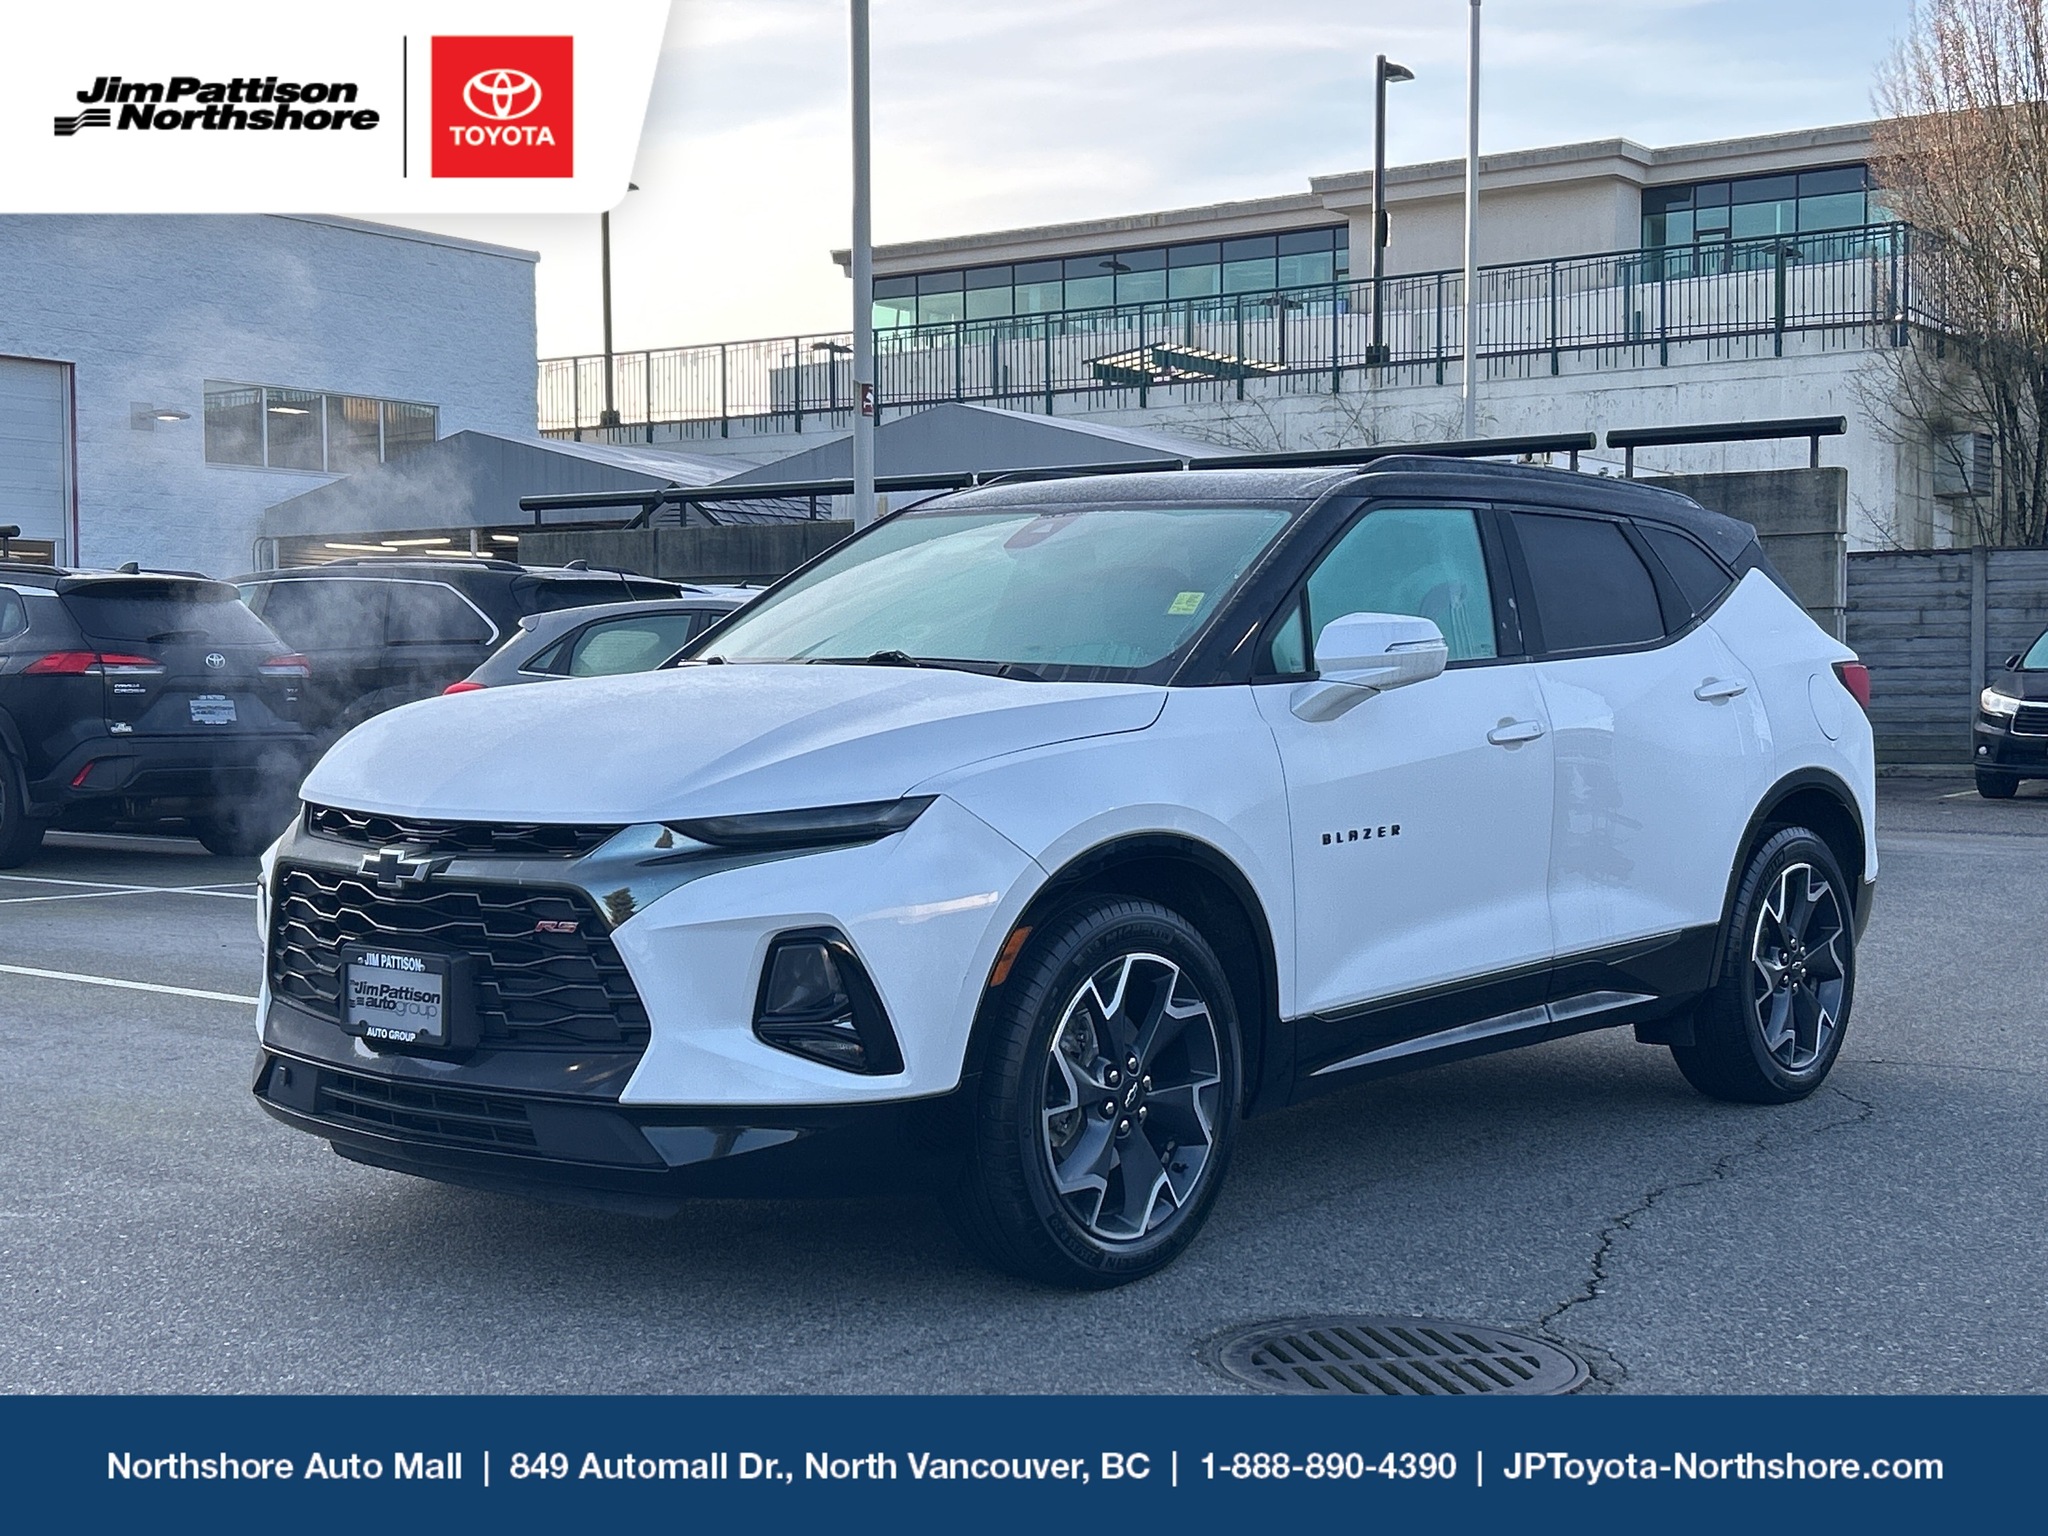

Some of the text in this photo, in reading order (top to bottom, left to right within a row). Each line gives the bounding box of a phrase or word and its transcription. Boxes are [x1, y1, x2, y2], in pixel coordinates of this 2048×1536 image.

[1322, 824, 1401, 845] BLAZER
[535, 920, 579, 933] RS
[365, 952, 422, 972] JIM PATTISON
[366, 1027, 416, 1042] AUTO GROUP
